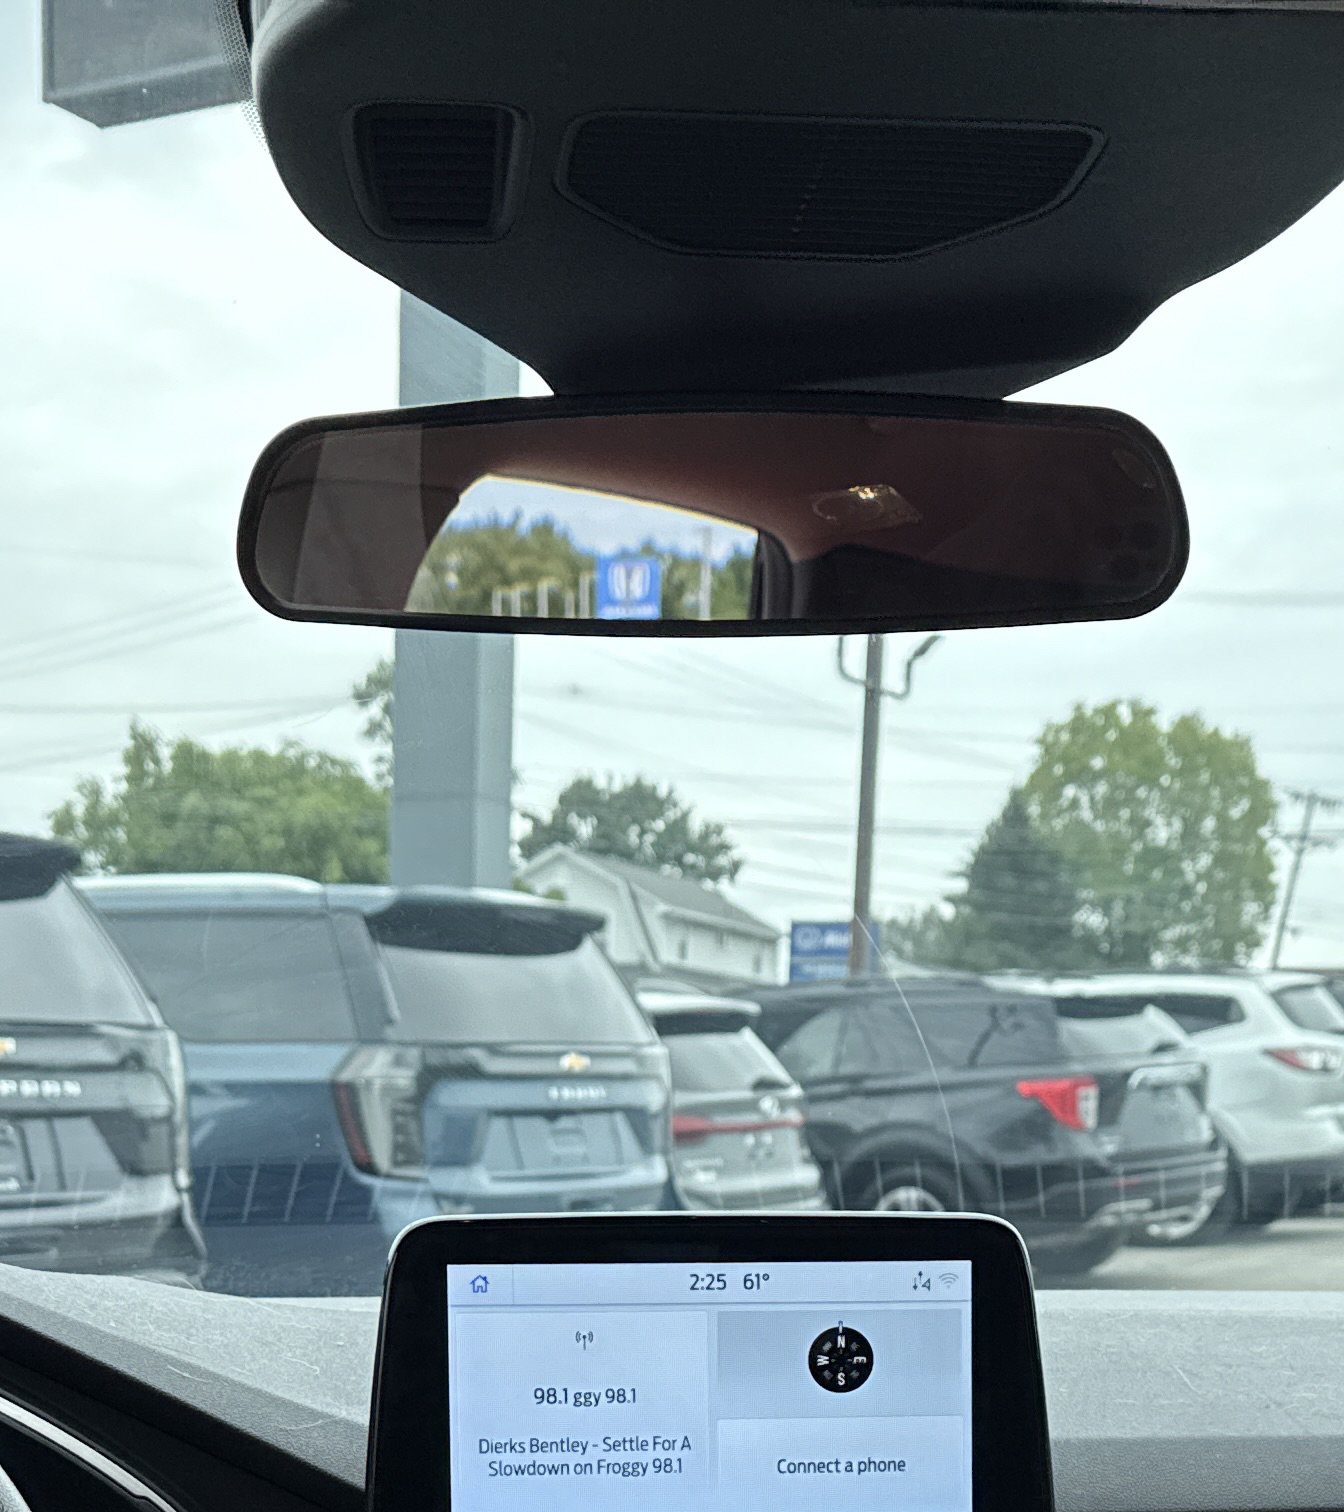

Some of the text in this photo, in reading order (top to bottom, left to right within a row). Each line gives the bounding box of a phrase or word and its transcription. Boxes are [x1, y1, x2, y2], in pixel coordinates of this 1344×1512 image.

[689, 1273, 727, 1291] 2:25
[742, 1272, 770, 1291] 61°
[533, 1387, 637, 1407] 98.1 ggy 98.1
[478, 1437, 526, 1454] Dierks
[529, 1436, 589, 1455] Bentley
[602, 1435, 649, 1452] Settle
[652, 1435, 677, 1451] For
[680, 1435, 692, 1451] A
[488, 1457, 683, 1477] Slowdown on Froggy 98.1
[777, 1457, 906, 1475] Connect a phone
